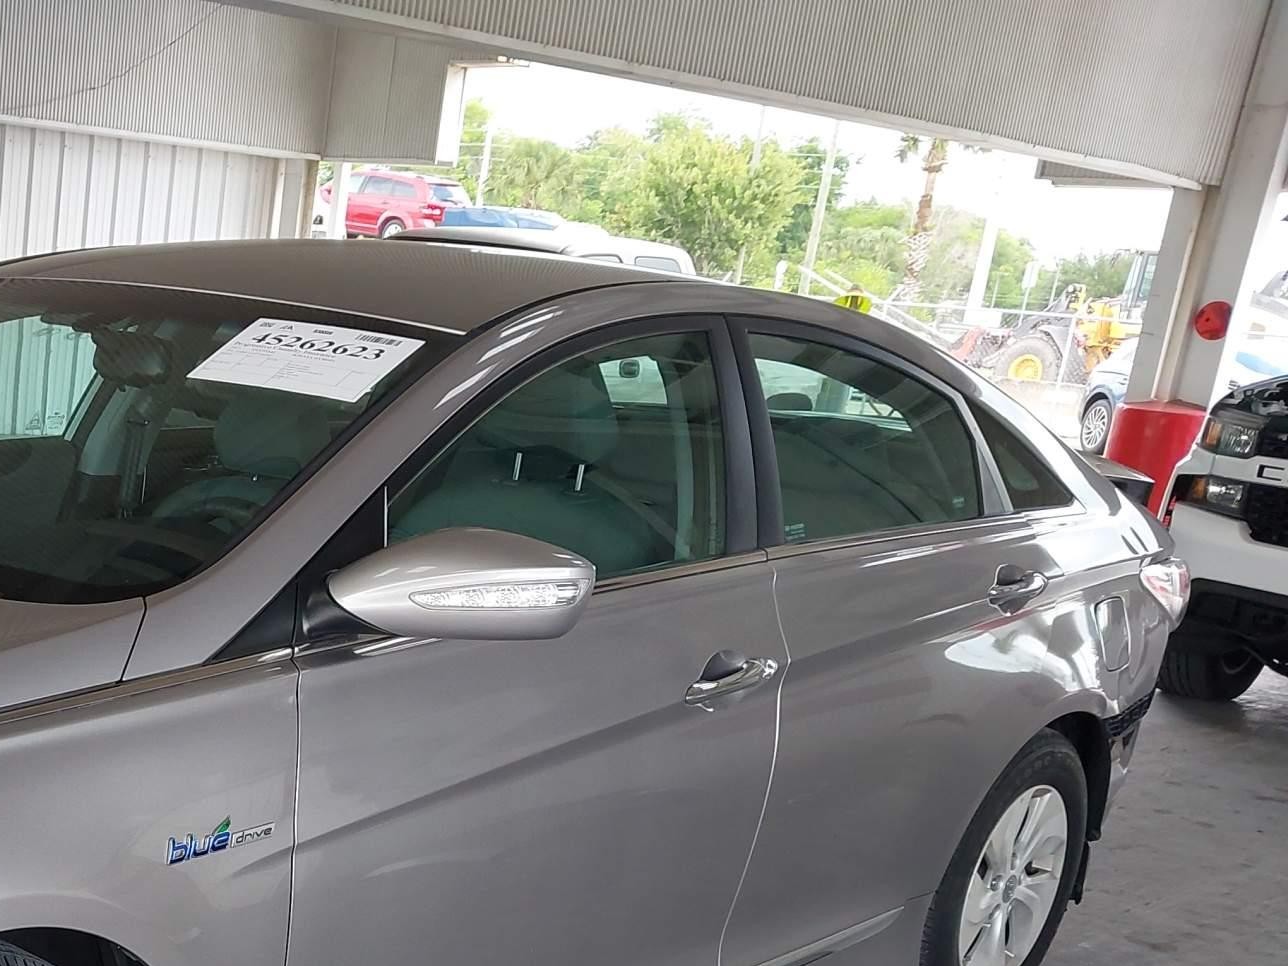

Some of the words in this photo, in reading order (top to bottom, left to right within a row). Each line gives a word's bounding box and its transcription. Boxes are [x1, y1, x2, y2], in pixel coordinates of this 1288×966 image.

[252, 332, 385, 361] 45262623
[166, 829, 231, 866] blue
[235, 827, 273, 844] drive
